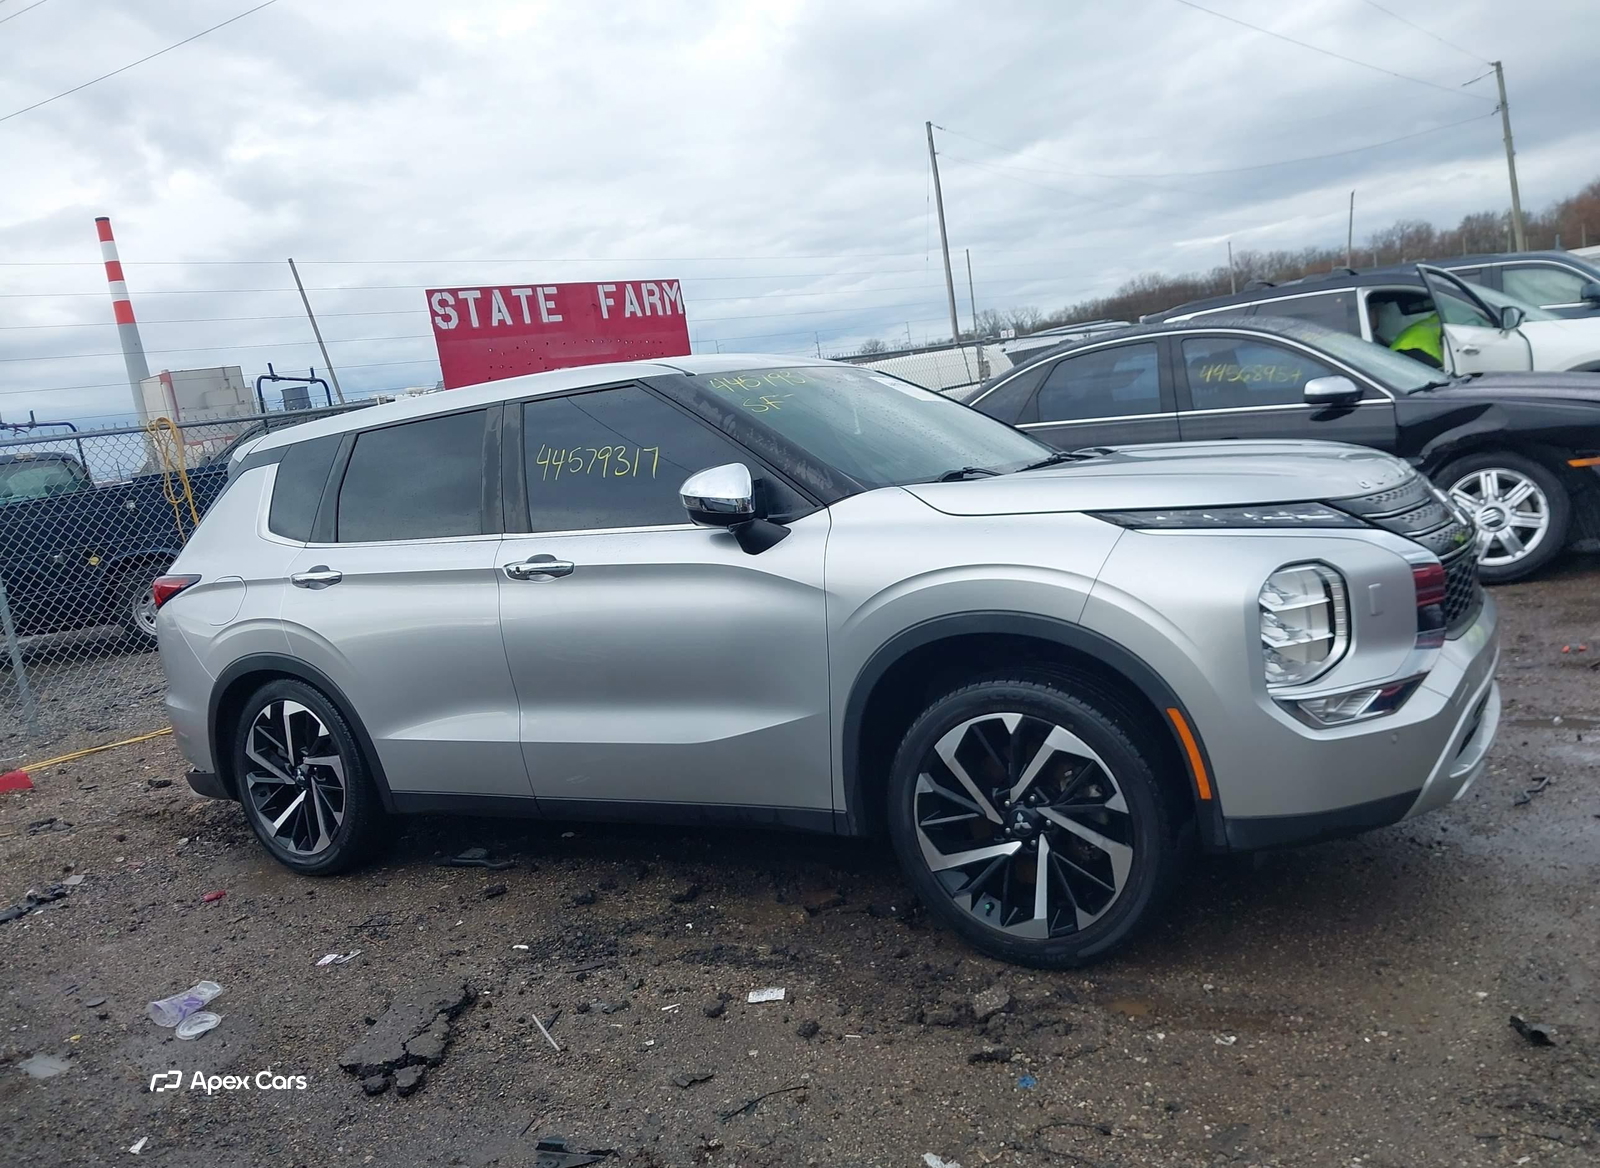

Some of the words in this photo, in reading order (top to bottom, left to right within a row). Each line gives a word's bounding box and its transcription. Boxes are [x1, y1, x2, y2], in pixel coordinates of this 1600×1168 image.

[430, 286, 563, 330] STATE
[596, 281, 685, 320] FARM
[536, 443, 660, 482] 44579317
